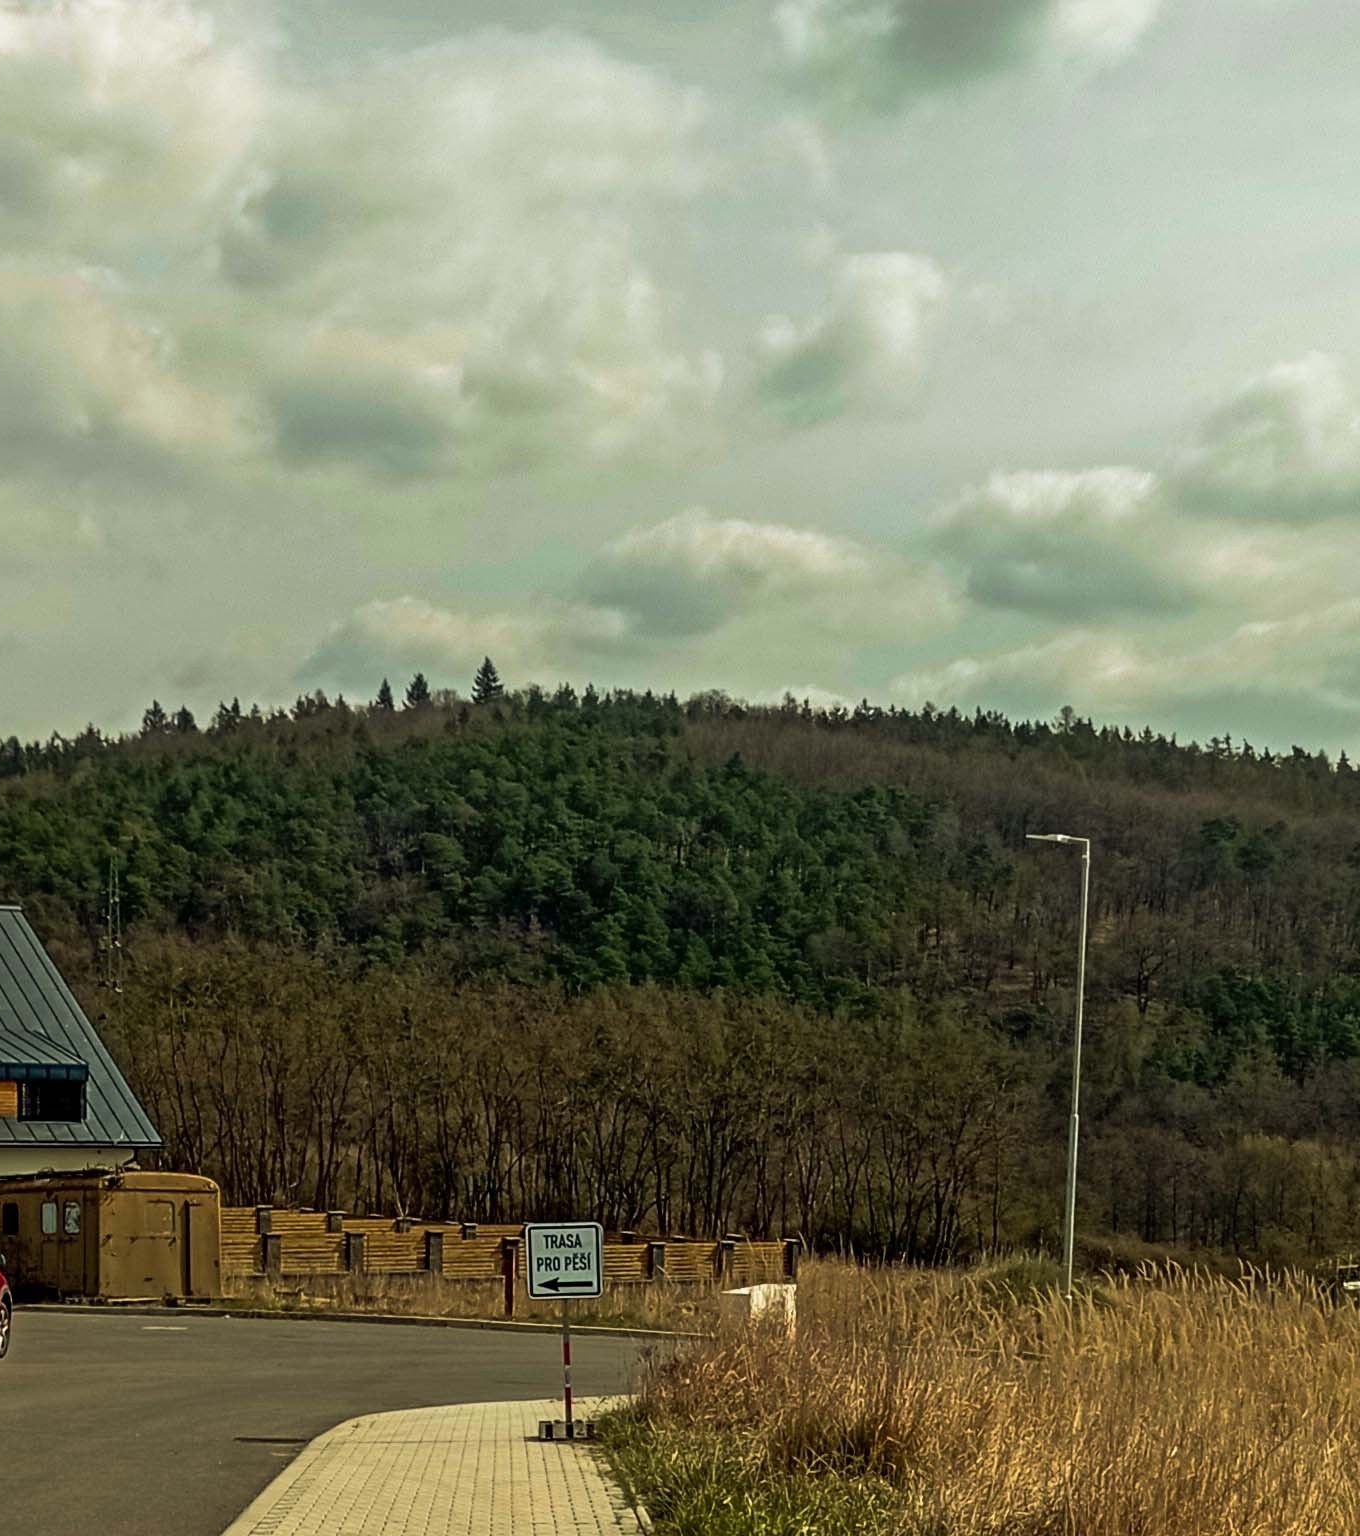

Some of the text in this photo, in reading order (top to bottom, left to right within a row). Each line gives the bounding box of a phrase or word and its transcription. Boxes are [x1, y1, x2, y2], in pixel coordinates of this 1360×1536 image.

[543, 1233, 583, 1249] TRASA
[536, 1252, 592, 1272] PRO PĚŠÍ
